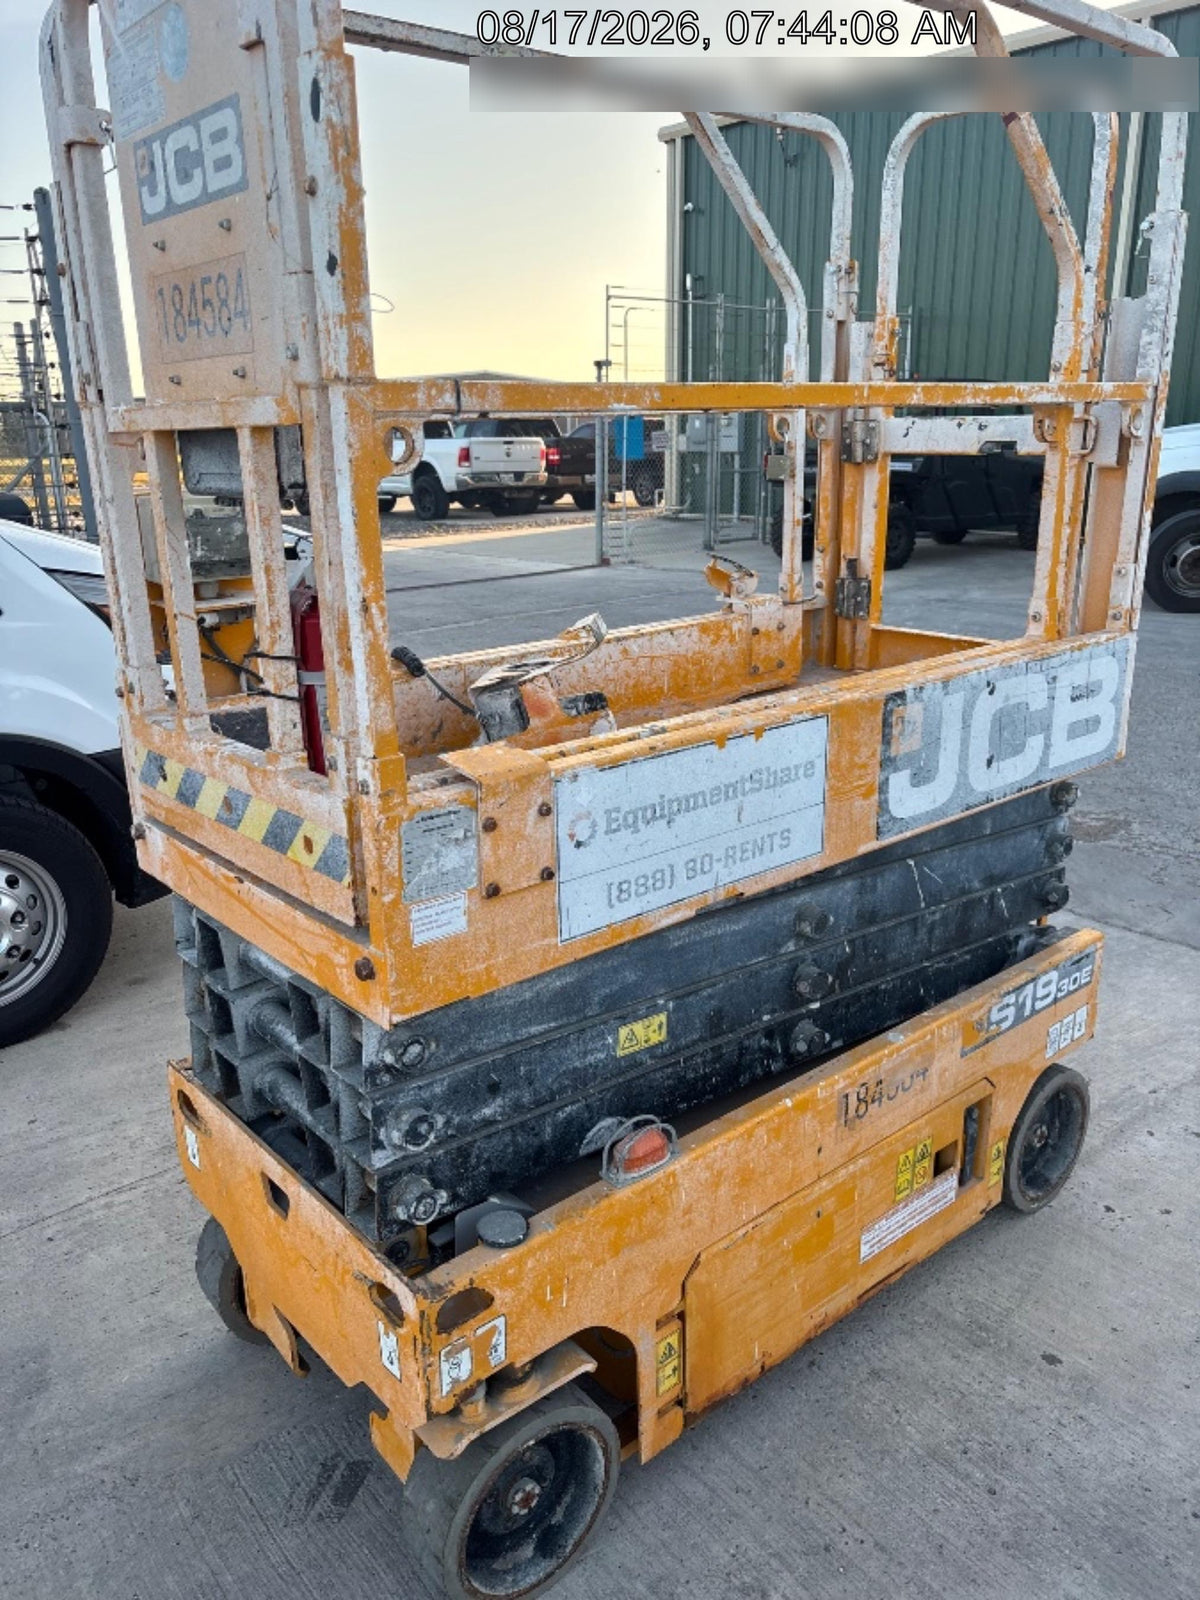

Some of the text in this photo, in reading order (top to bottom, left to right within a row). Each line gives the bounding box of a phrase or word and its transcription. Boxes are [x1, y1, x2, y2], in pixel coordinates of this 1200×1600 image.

[141, 108, 242, 214] JCB
[157, 267, 248, 344] 184584
[888, 655, 1120, 818] JCB
[603, 759, 816, 836] EquipmentShare
